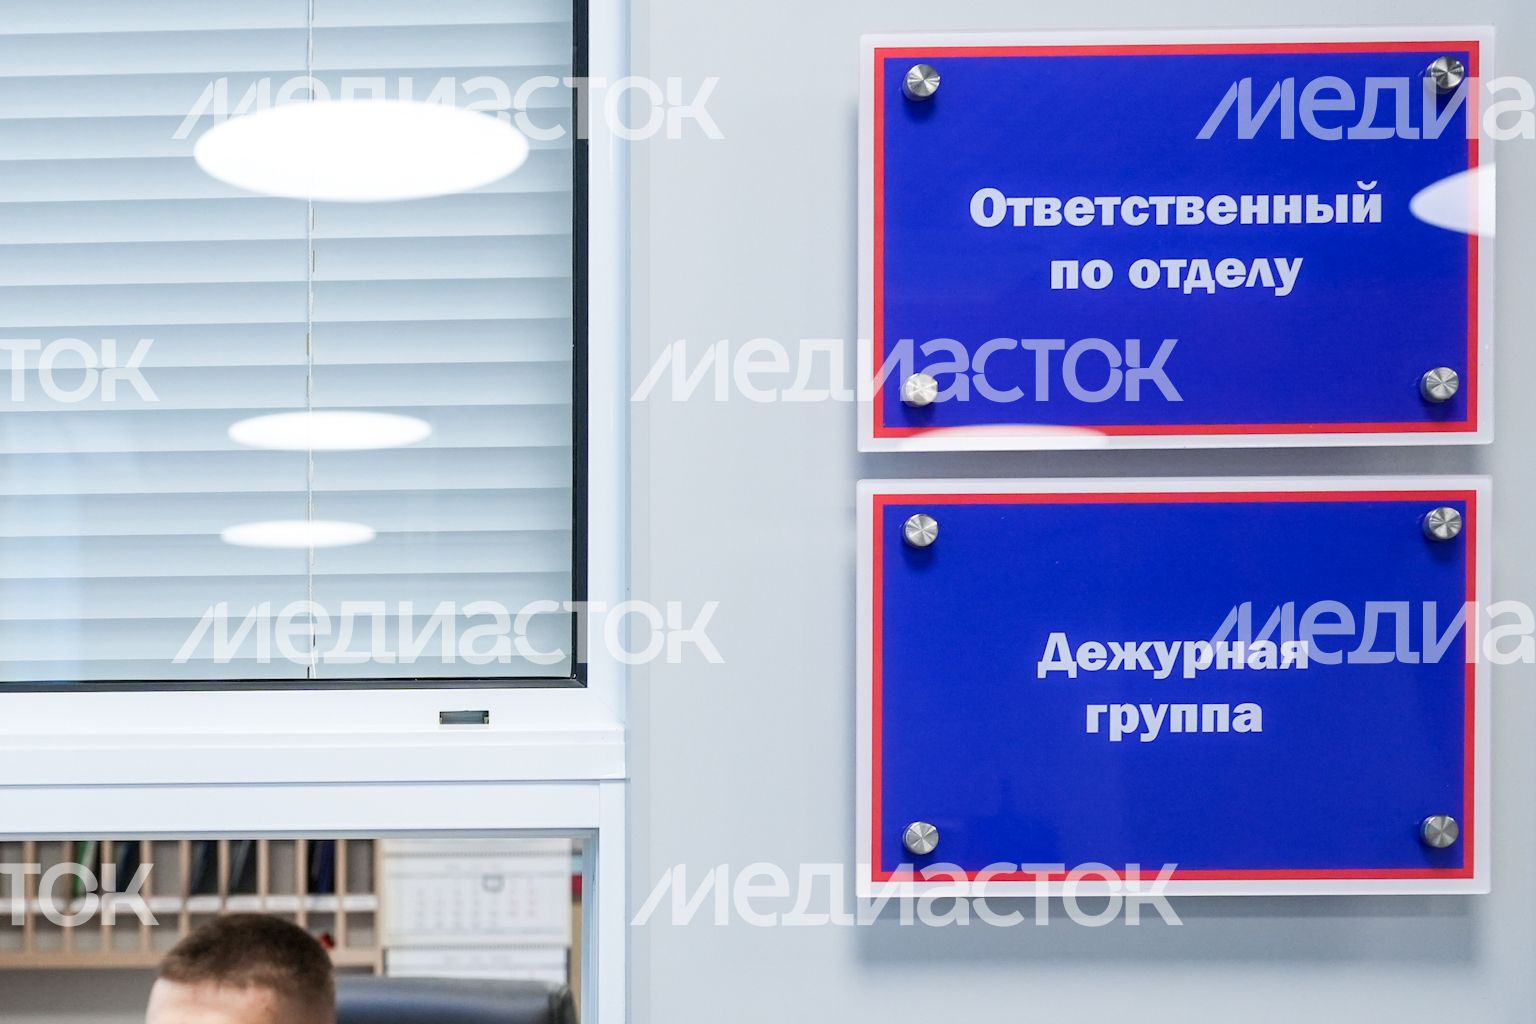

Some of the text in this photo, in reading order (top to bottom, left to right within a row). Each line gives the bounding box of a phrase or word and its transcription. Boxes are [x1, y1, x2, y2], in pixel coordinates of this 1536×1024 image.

[969, 180, 1383, 228] Ответственный
[1049, 257, 1304, 297] по отделу
[1036, 631, 1310, 680] Дежурная
[1085, 702, 1264, 743] группа
